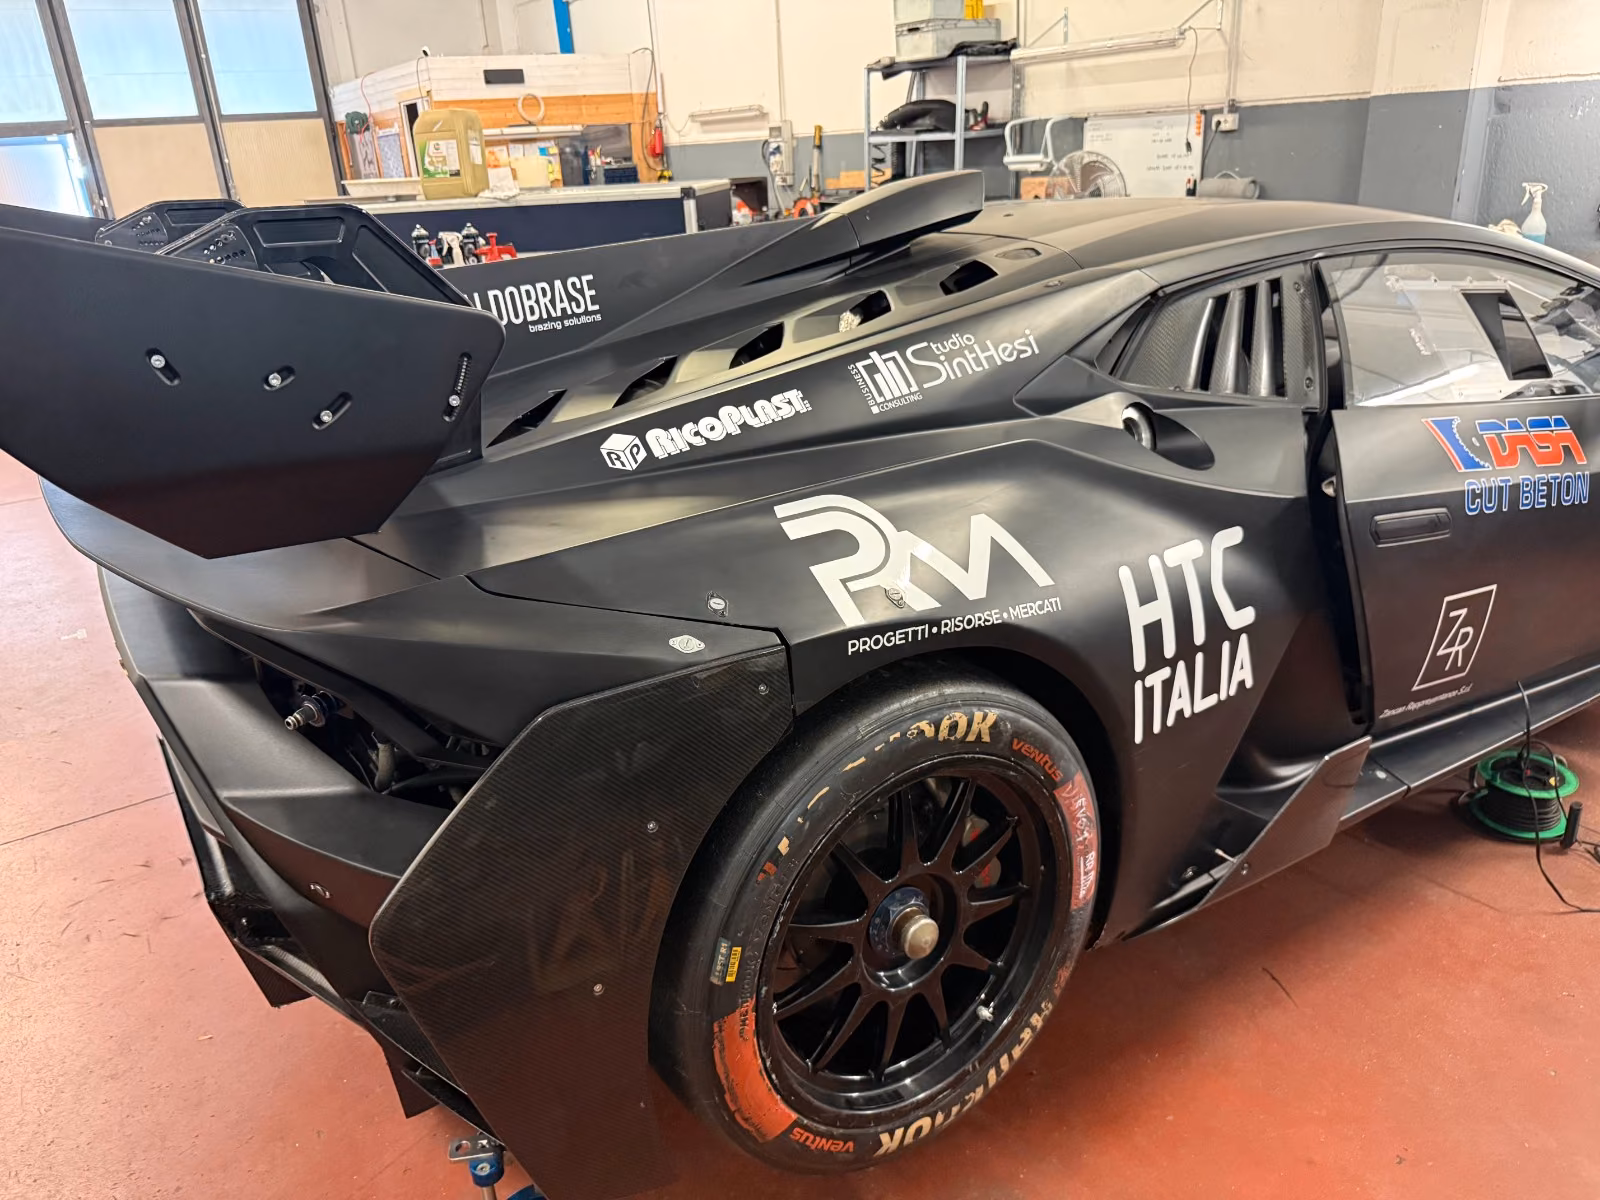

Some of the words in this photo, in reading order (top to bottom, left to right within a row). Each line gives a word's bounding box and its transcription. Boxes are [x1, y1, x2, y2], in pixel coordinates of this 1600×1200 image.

[528, 320, 562, 333] brazing
[564, 313, 602, 327] solutions
[848, 364, 876, 406] BUSINESS
[879, 392, 923, 412] CONSULTING
[1464, 476, 1513, 515] CUT
[1519, 472, 1590, 510] BETON
[1118, 525, 1256, 673] HTC
[848, 623, 929, 655] PROGETTI
[941, 609, 1002, 635] RISORSE
[1009, 597, 1062, 621] MERCATI
[1134, 632, 1254, 745] ITALIA
